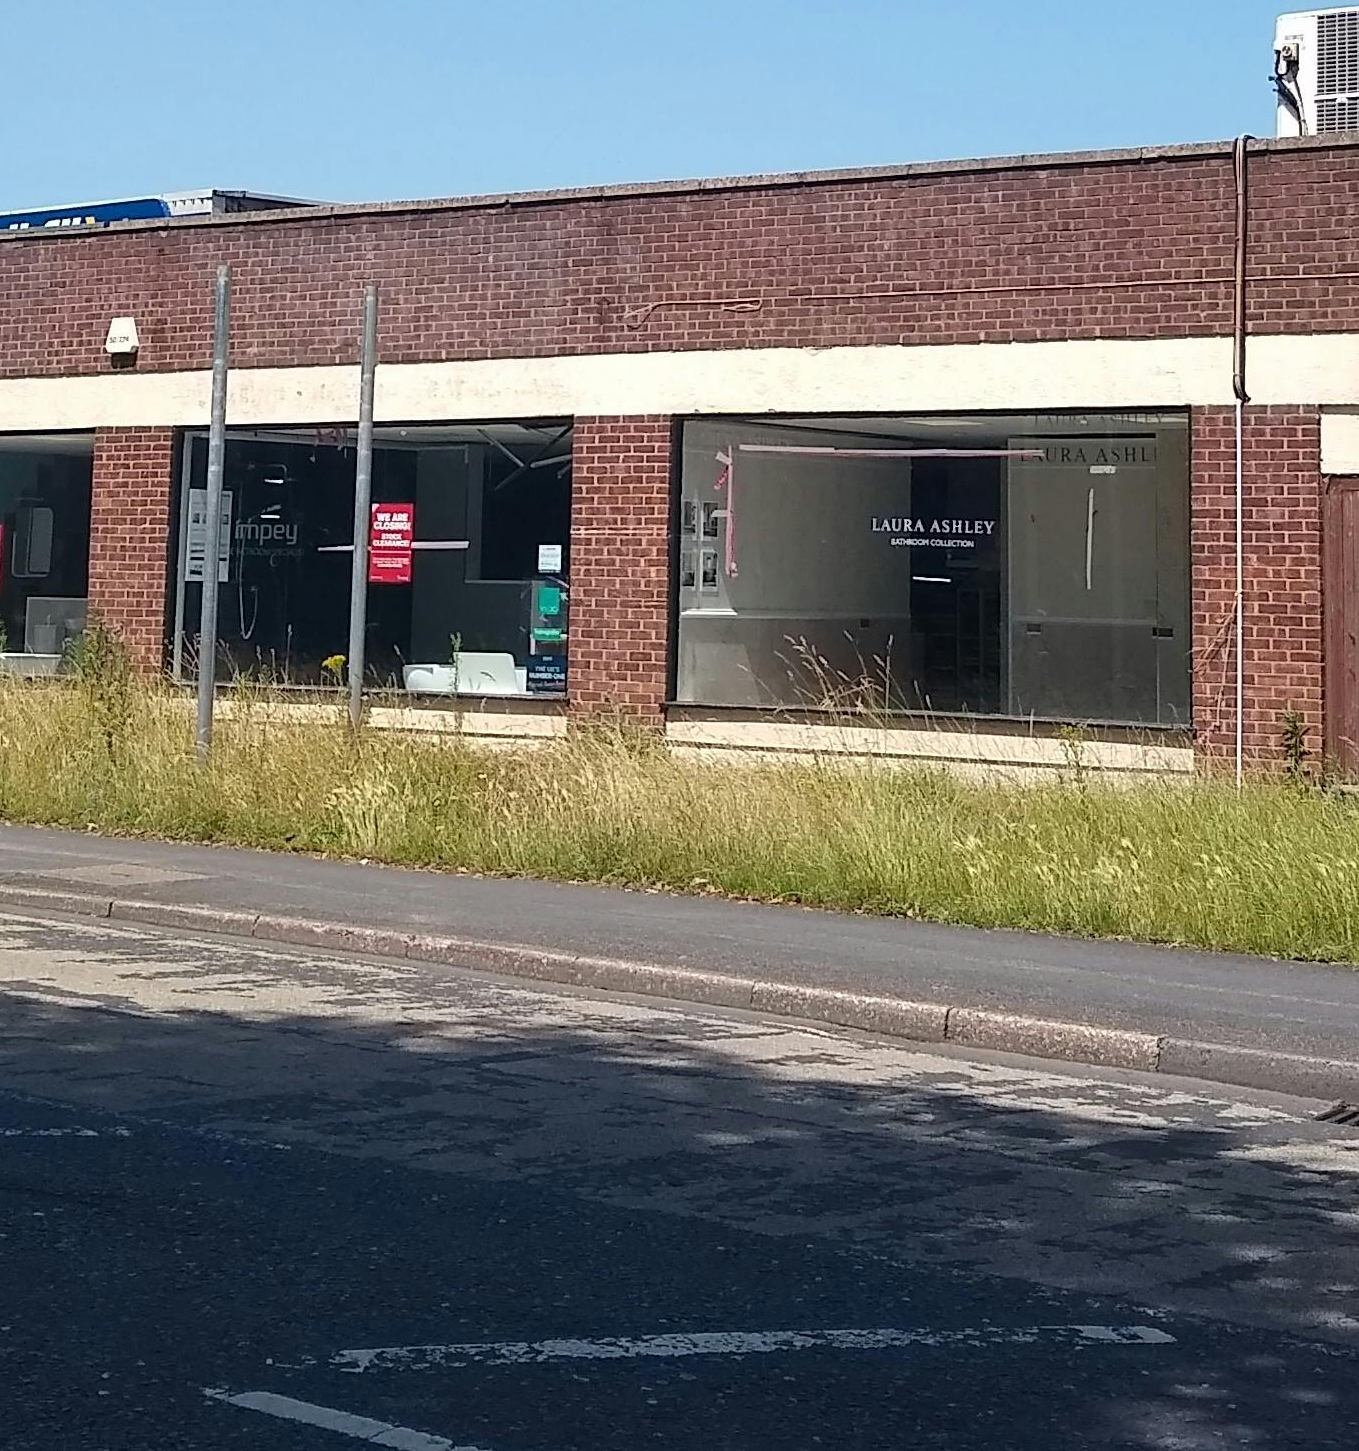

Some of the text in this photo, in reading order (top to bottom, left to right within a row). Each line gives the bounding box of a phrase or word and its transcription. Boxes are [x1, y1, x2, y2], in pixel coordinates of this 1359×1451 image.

[376, 512, 409, 522] WE ARE
[871, 517, 995, 535] LAURA ASHLEY
[890, 537, 975, 548] BATHROOM COLLECTION
